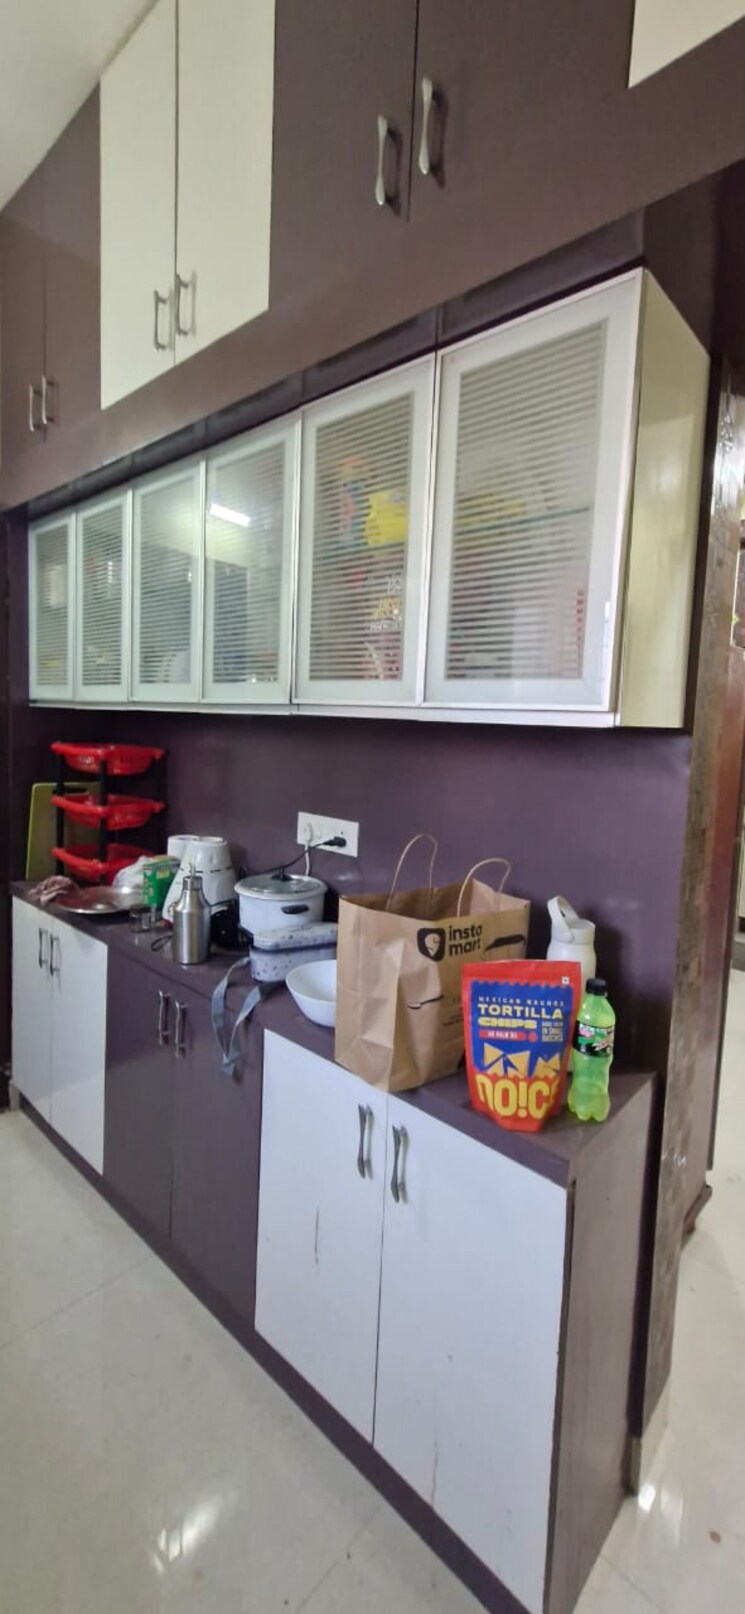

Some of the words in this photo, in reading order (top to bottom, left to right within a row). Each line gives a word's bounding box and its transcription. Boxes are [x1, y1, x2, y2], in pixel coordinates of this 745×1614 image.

[448, 940, 481, 956] mart
[478, 996, 521, 1004] MEXICAN
[526, 999, 564, 1007] NACHOS
[477, 1003, 563, 1019] TORTILLA
[477, 1016, 538, 1029] CHIPS
